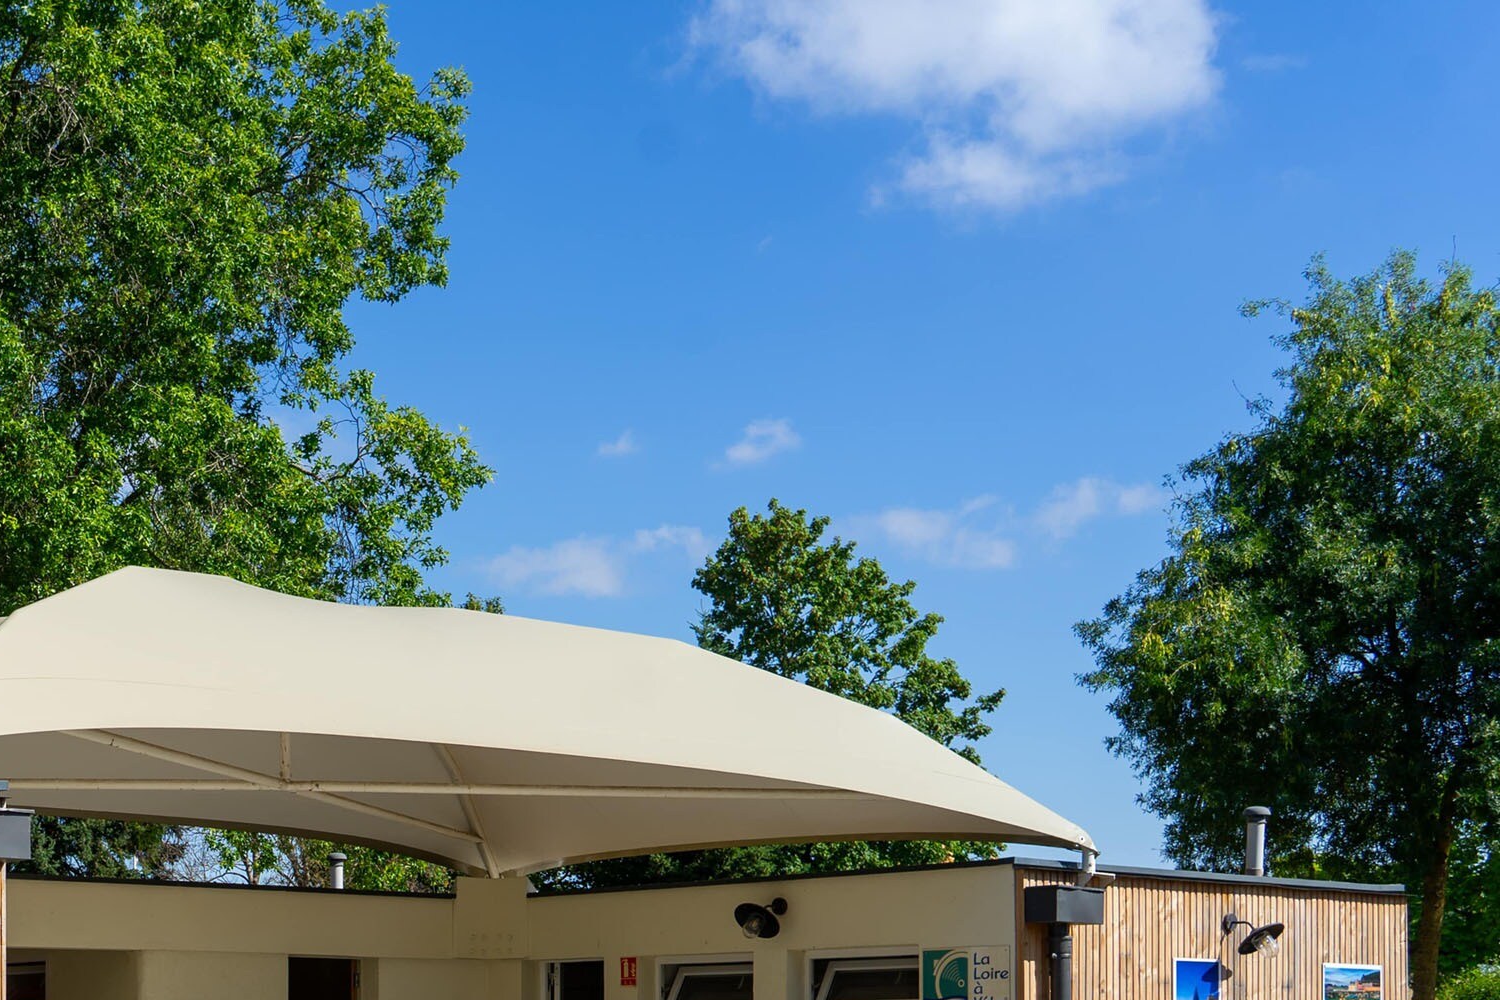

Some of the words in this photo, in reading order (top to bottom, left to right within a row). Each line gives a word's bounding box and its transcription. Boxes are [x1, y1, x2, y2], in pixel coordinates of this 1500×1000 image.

[974, 952, 990, 965] La
[974, 967, 1009, 980] Loire
[973, 981, 983, 994] à
